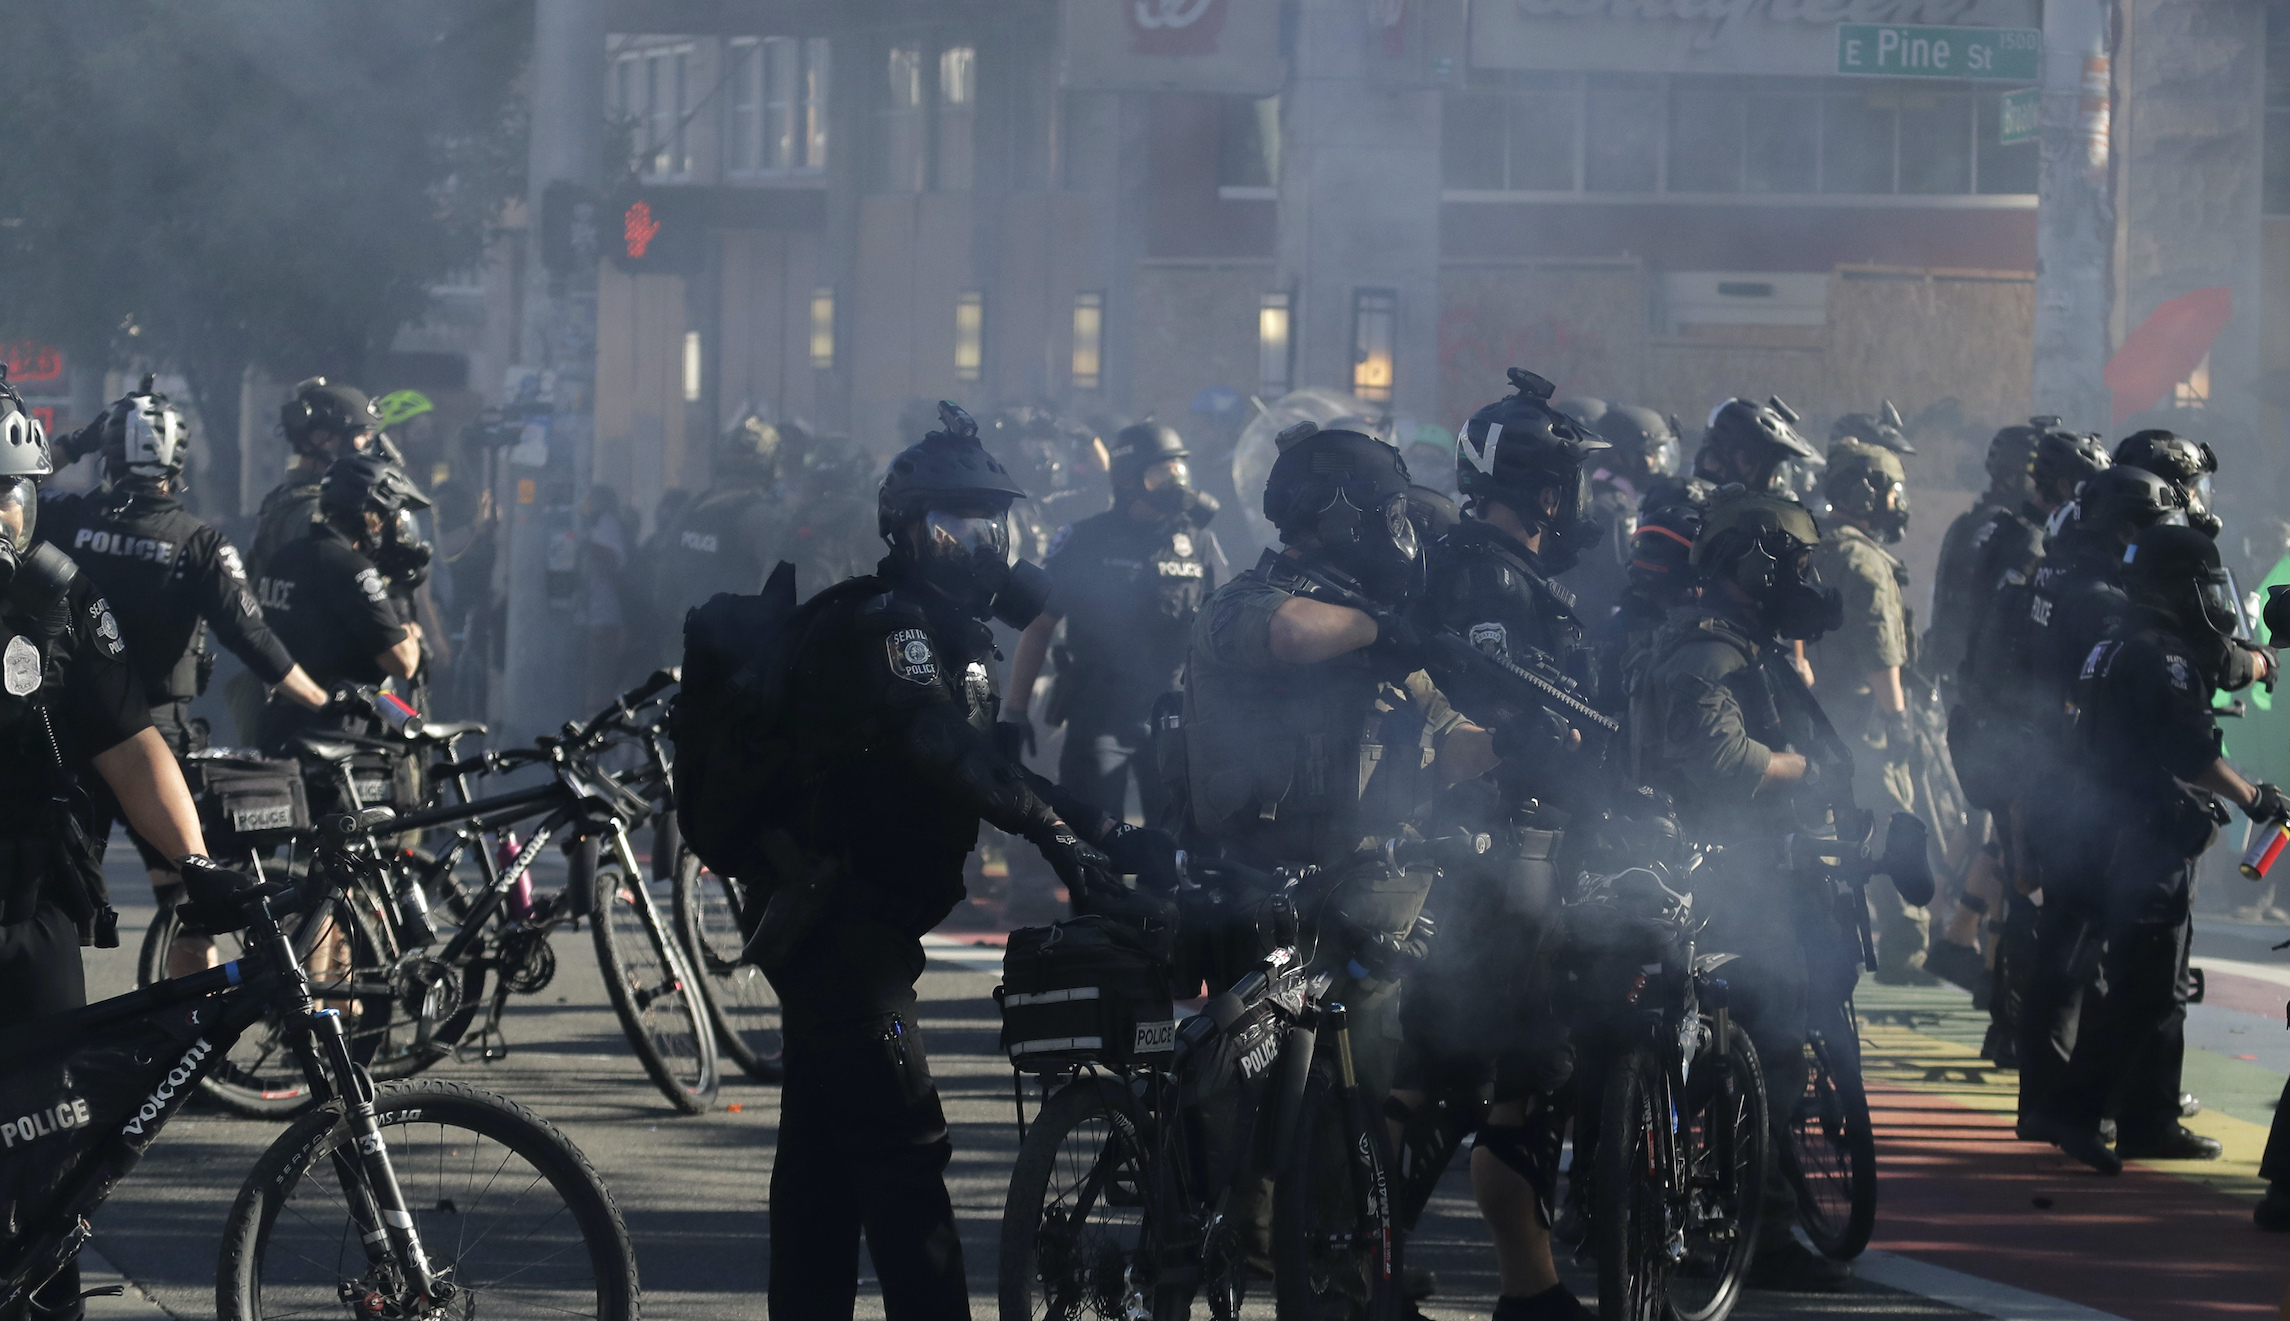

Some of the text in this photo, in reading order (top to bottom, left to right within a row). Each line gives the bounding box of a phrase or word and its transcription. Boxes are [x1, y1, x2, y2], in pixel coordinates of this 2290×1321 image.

[1846, 28, 1993, 71] E Pine St
[2001, 32, 2037, 51] 1500
[74, 527, 174, 564] POLICE
[1157, 561, 1204, 578] POLICE
[238, 810, 288, 826] POLICE
[186, 856, 217, 871] FOX
[1137, 1027, 1173, 1046] POLICE
[1241, 1033, 1279, 1079] POLICE
[1, 1098, 91, 1149] POLICE
[360, 1131, 386, 1156] 32
